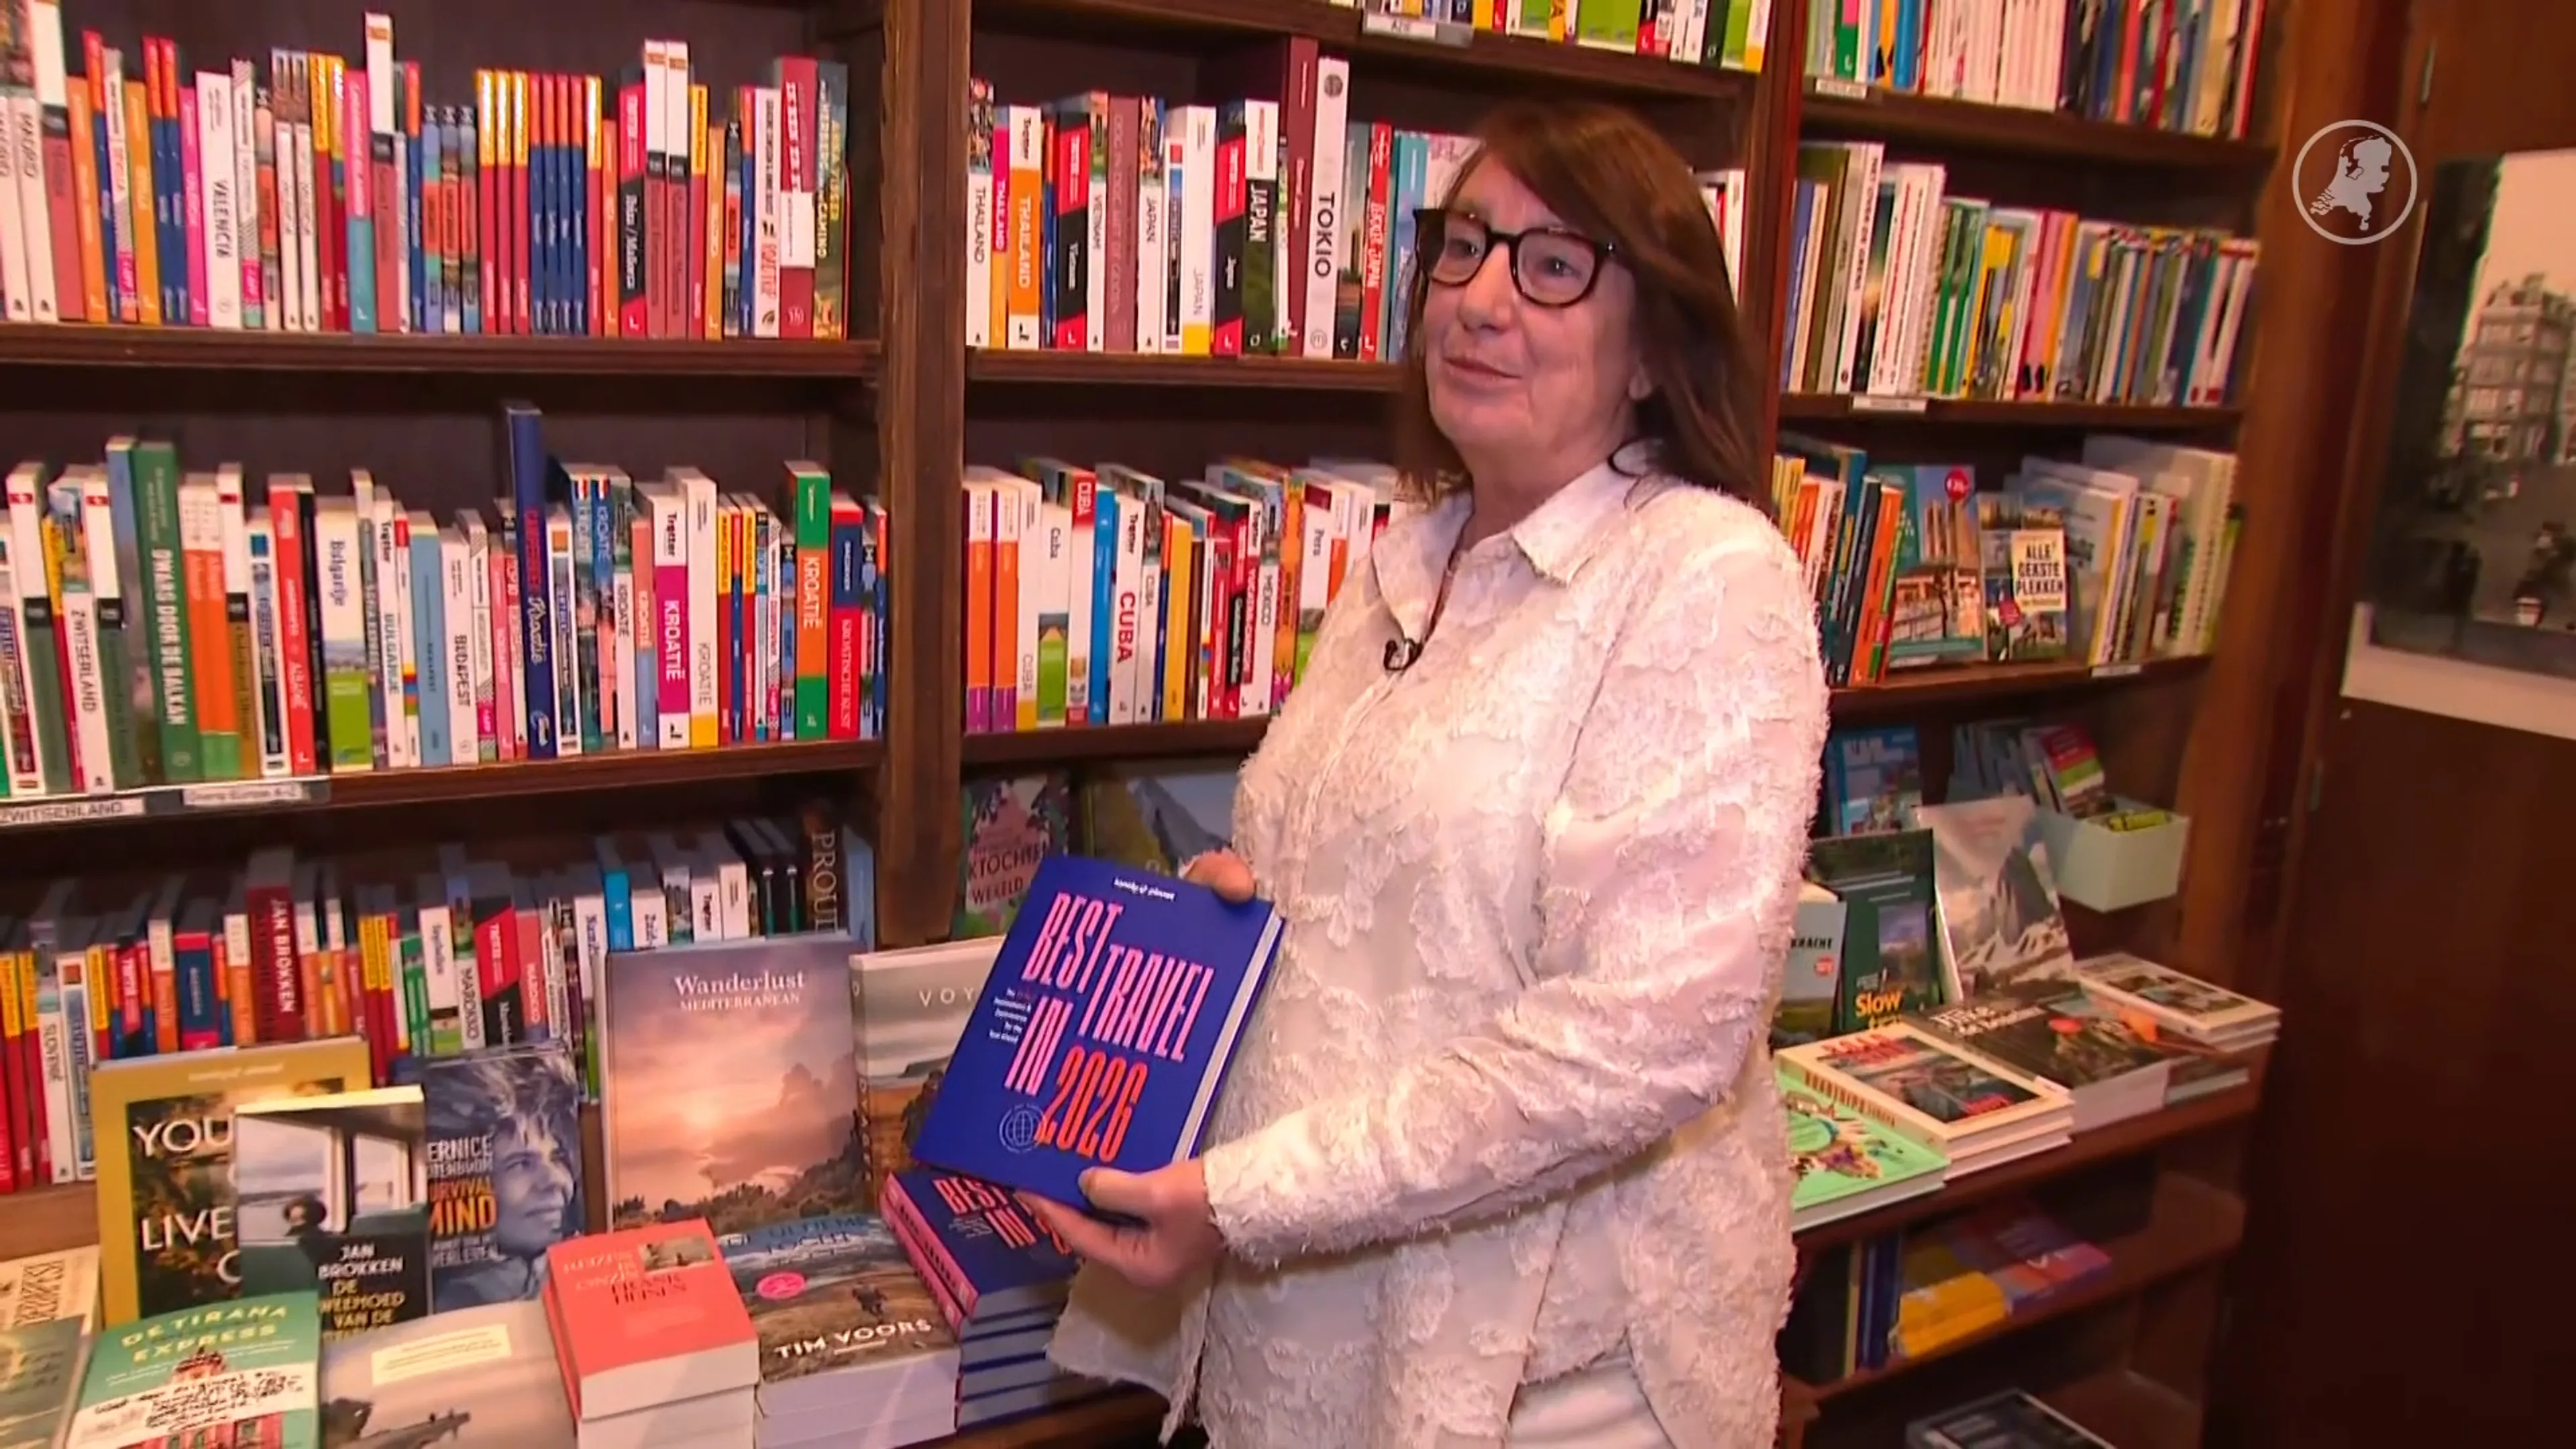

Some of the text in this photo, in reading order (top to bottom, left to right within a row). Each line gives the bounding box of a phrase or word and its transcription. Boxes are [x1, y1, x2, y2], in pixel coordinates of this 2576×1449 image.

[213, 180, 231, 258] VALENCIA
[973, 186, 986, 264] THAILAND
[994, 180, 1006, 250] THAILAND
[1092, 194, 1103, 251] VIETNAM
[1145, 196, 1157, 244] JAPAN
[1248, 184, 1268, 243] JAPAN
[1314, 191, 1336, 278] TOKIO
[1017, 196, 1032, 290] THAILAND
[1192, 268, 1204, 316] JAPAN
[1077, 481, 1093, 515] CUBA
[1049, 527, 1061, 559] Cuba
[2026, 543, 2051, 559] ALLE
[327, 539, 347, 608] Bulgarije
[802, 556, 822, 629] KROATIË
[1144, 574, 1155, 607] CUBA
[1260, 574, 1273, 626] MEXICO
[150, 548, 187, 724] DWARS DOOR DE BALKAN
[663, 600, 685, 682] KROATIË
[1116, 592, 1136, 664] CUBA
[70, 608, 97, 713] ZWITSERLAND
[383, 612, 400, 695] BULGARIJE
[453, 634, 471, 707] BUDAPEST
[1022, 653, 1034, 692] CUBA
[270, 899, 294, 1013] JAN BROKKEN
[1022, 892, 1125, 994] BEST
[461, 967, 479, 1040] MAROKKO
[674, 970, 805, 997] Wanderlust
[680, 991, 800, 1012] MEDITERRANEAN
[919, 987, 977, 1008] VOY
[1077, 943, 1214, 1063] TRAVEL
[1855, 989, 1901, 1018] Slow
[1004, 996, 1073, 1096] IN
[1033, 1044, 1149, 1164] 2026
[133, 1116, 234, 1157] YOU
[427, 1136, 492, 1162] ERNICE
[429, 1176, 493, 1201] URVIVAL
[932, 1177, 1008, 1215] BEST
[141, 1207, 234, 1252] LIVE
[429, 1195, 496, 1236] MIND
[983, 1207, 1036, 1249] IN
[318, 1256, 403, 1279] BROKKEN
[339, 1244, 374, 1262] JAN
[332, 1279, 358, 1295] DE
[121, 1306, 288, 1348] DE TIRANA
[133, 1324, 277, 1362] EXPRESS
[333, 1311, 368, 1329] VAN
[774, 1318, 932, 1358] TIM VOORS
